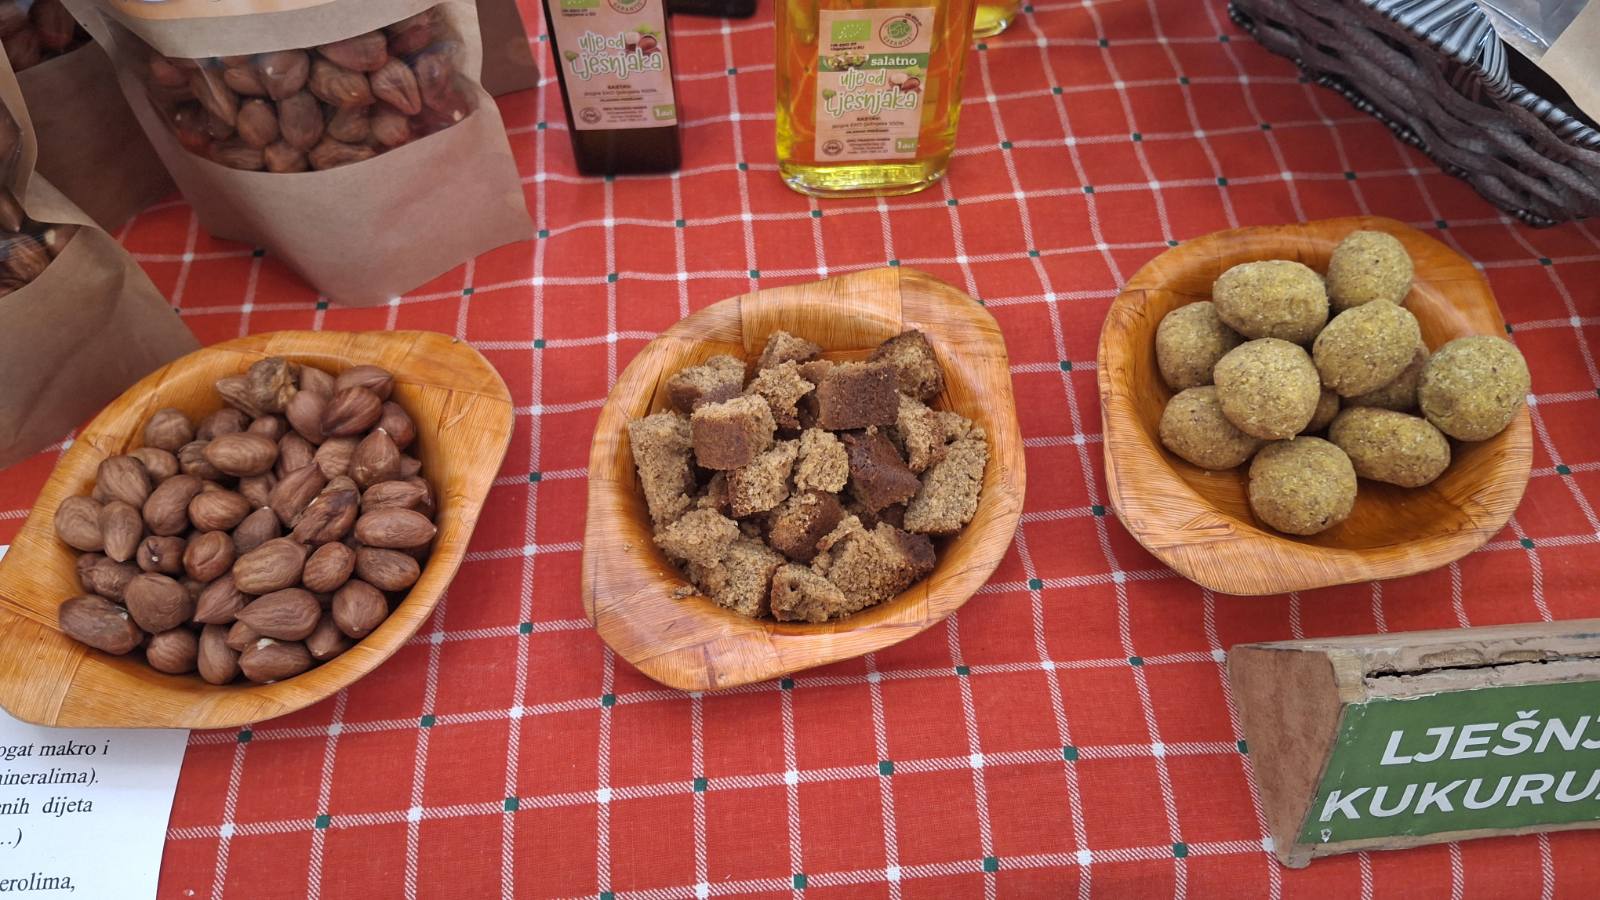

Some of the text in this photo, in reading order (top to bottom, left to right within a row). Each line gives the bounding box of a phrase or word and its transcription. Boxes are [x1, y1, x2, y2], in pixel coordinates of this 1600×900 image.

[578, 31, 625, 55] ulje od
[870, 56, 917, 67] salatno
[840, 69, 886, 91] ulje od
[38, 741, 96, 757] makro
[102, 740, 110, 755] i
[1319, 770, 1600, 822] KUKURU
[42, 797, 93, 818] dijeta
